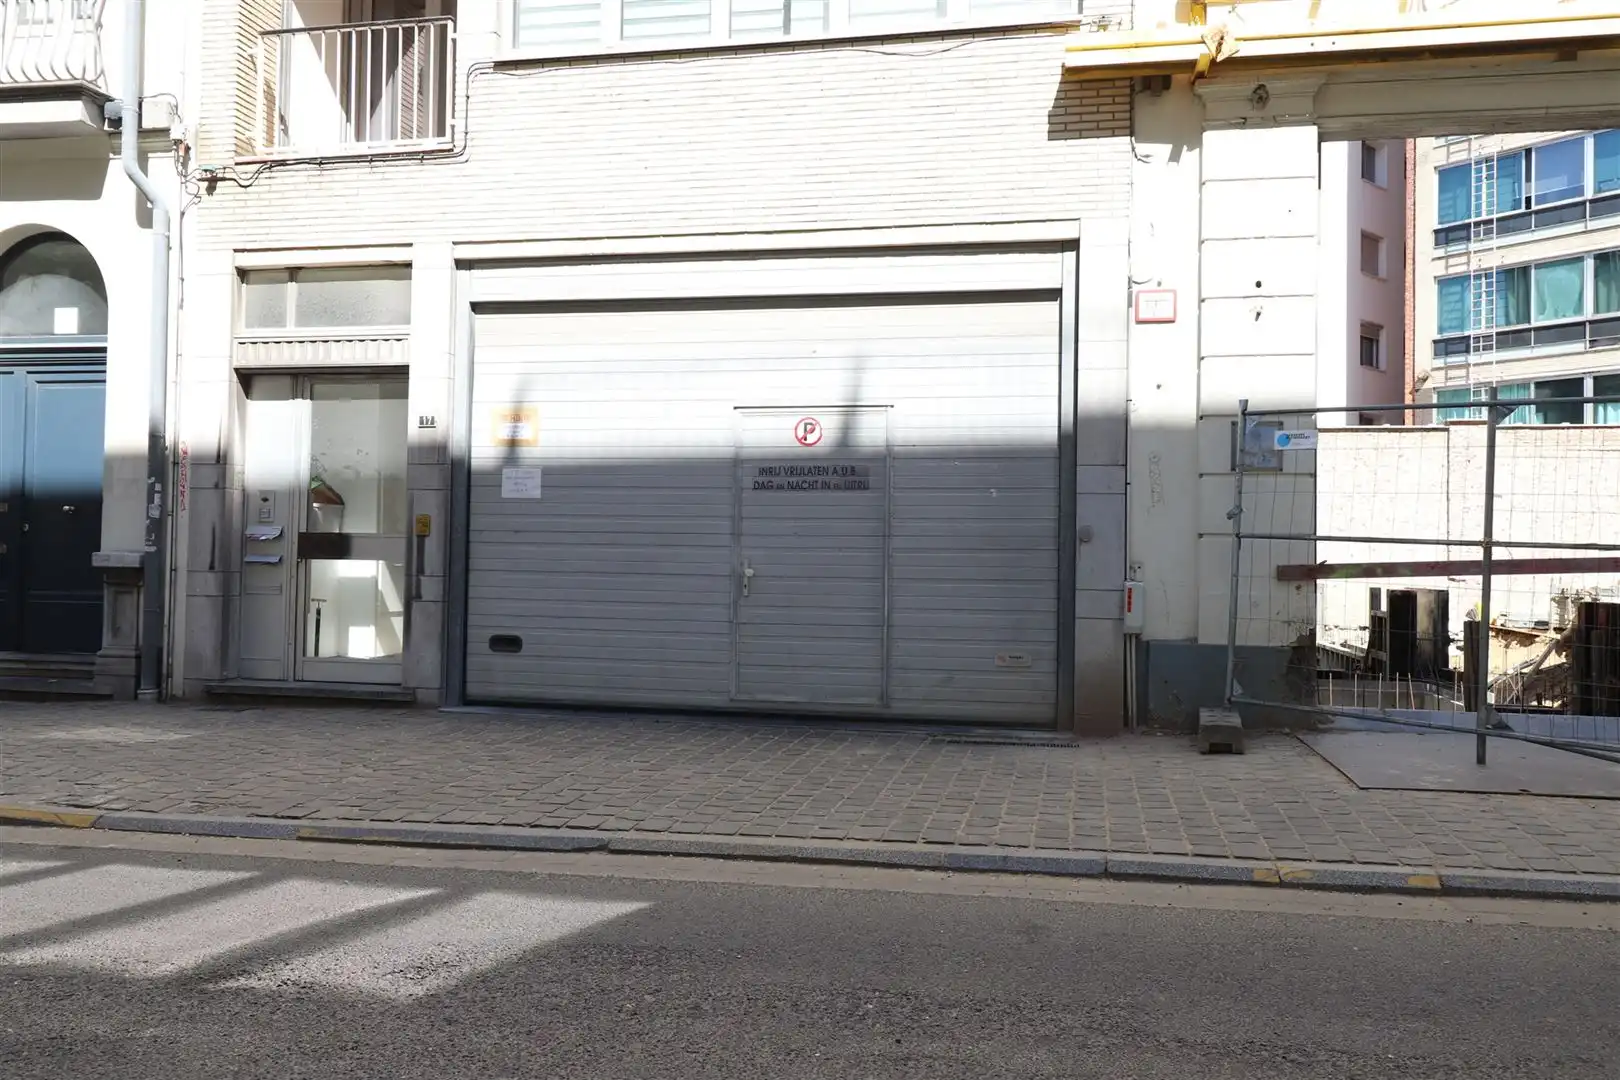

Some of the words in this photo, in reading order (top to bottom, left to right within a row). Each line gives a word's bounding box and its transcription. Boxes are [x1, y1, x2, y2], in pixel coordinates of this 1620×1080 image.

[783, 464, 828, 476] VRIJLATEN
[753, 479, 773, 489] DAG
[787, 479, 818, 489] NACHT
[844, 479, 869, 490] UITRIJ
